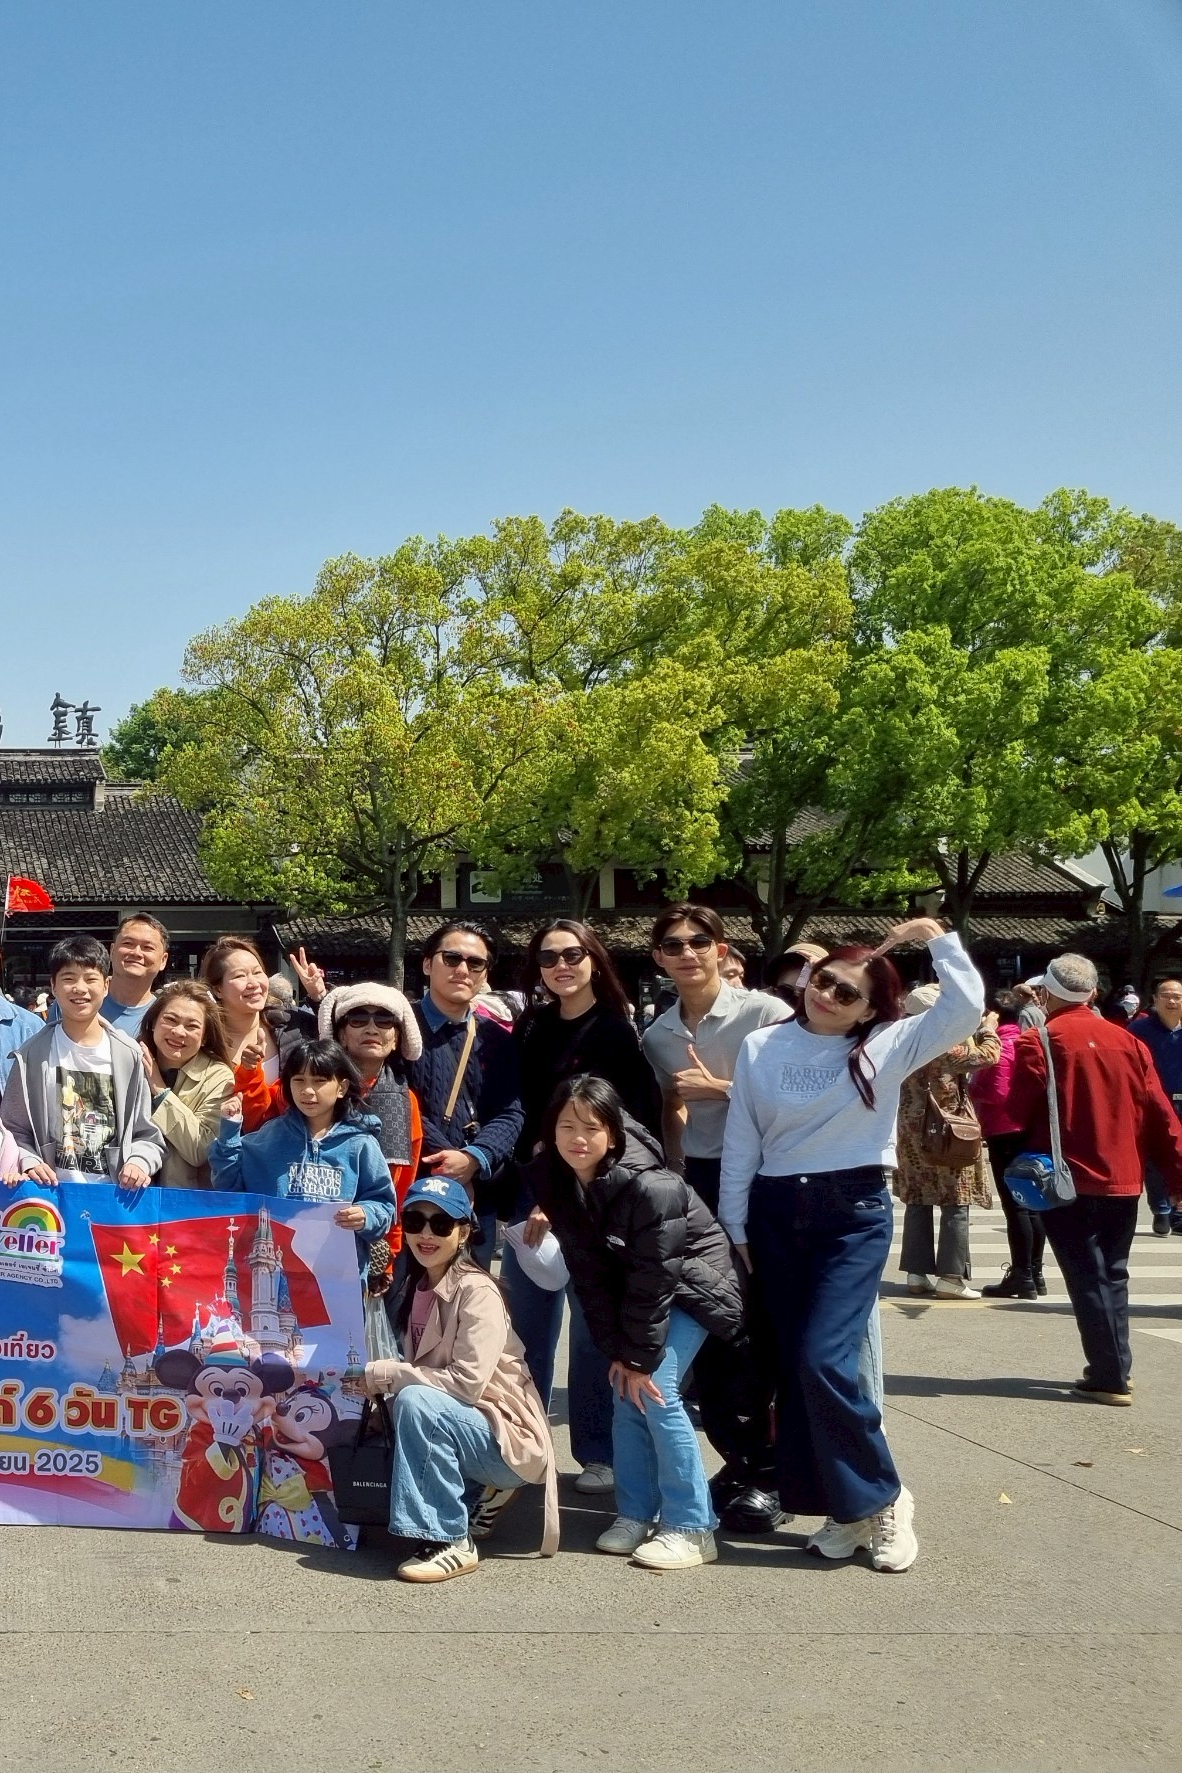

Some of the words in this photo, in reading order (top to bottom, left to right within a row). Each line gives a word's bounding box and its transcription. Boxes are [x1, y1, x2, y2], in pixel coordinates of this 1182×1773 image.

[6, 1272, 33, 1281] AGENCY
[26, 1394, 55, 1426] 6
[66, 1389, 115, 1429] วัน
[127, 1397, 181, 1431] TG
[36, 1451, 100, 1473] 2025
